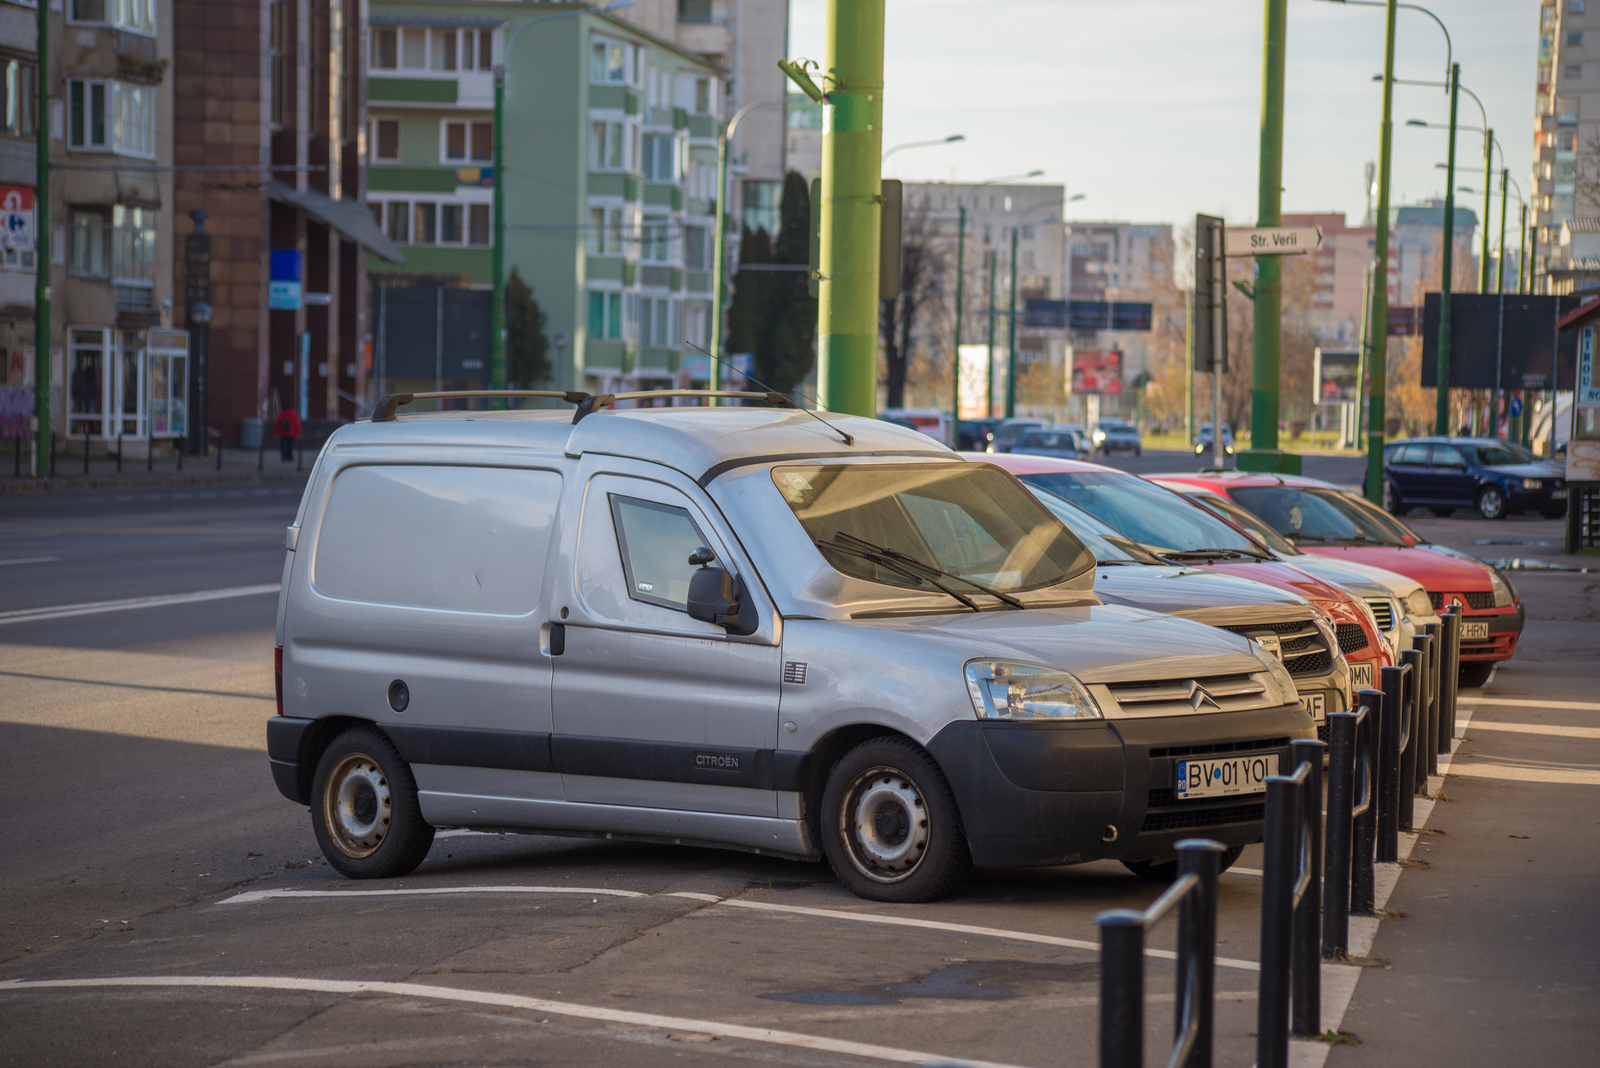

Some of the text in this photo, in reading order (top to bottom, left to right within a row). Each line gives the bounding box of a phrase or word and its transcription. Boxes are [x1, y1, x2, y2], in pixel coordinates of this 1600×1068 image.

[1251, 232, 1297, 248] Str. Verii
[1467, 625, 1487, 637] HRN
[1189, 763, 1214, 788] BV
[1222, 761, 1238, 785] 01
[1178, 780, 1186, 790] RO
